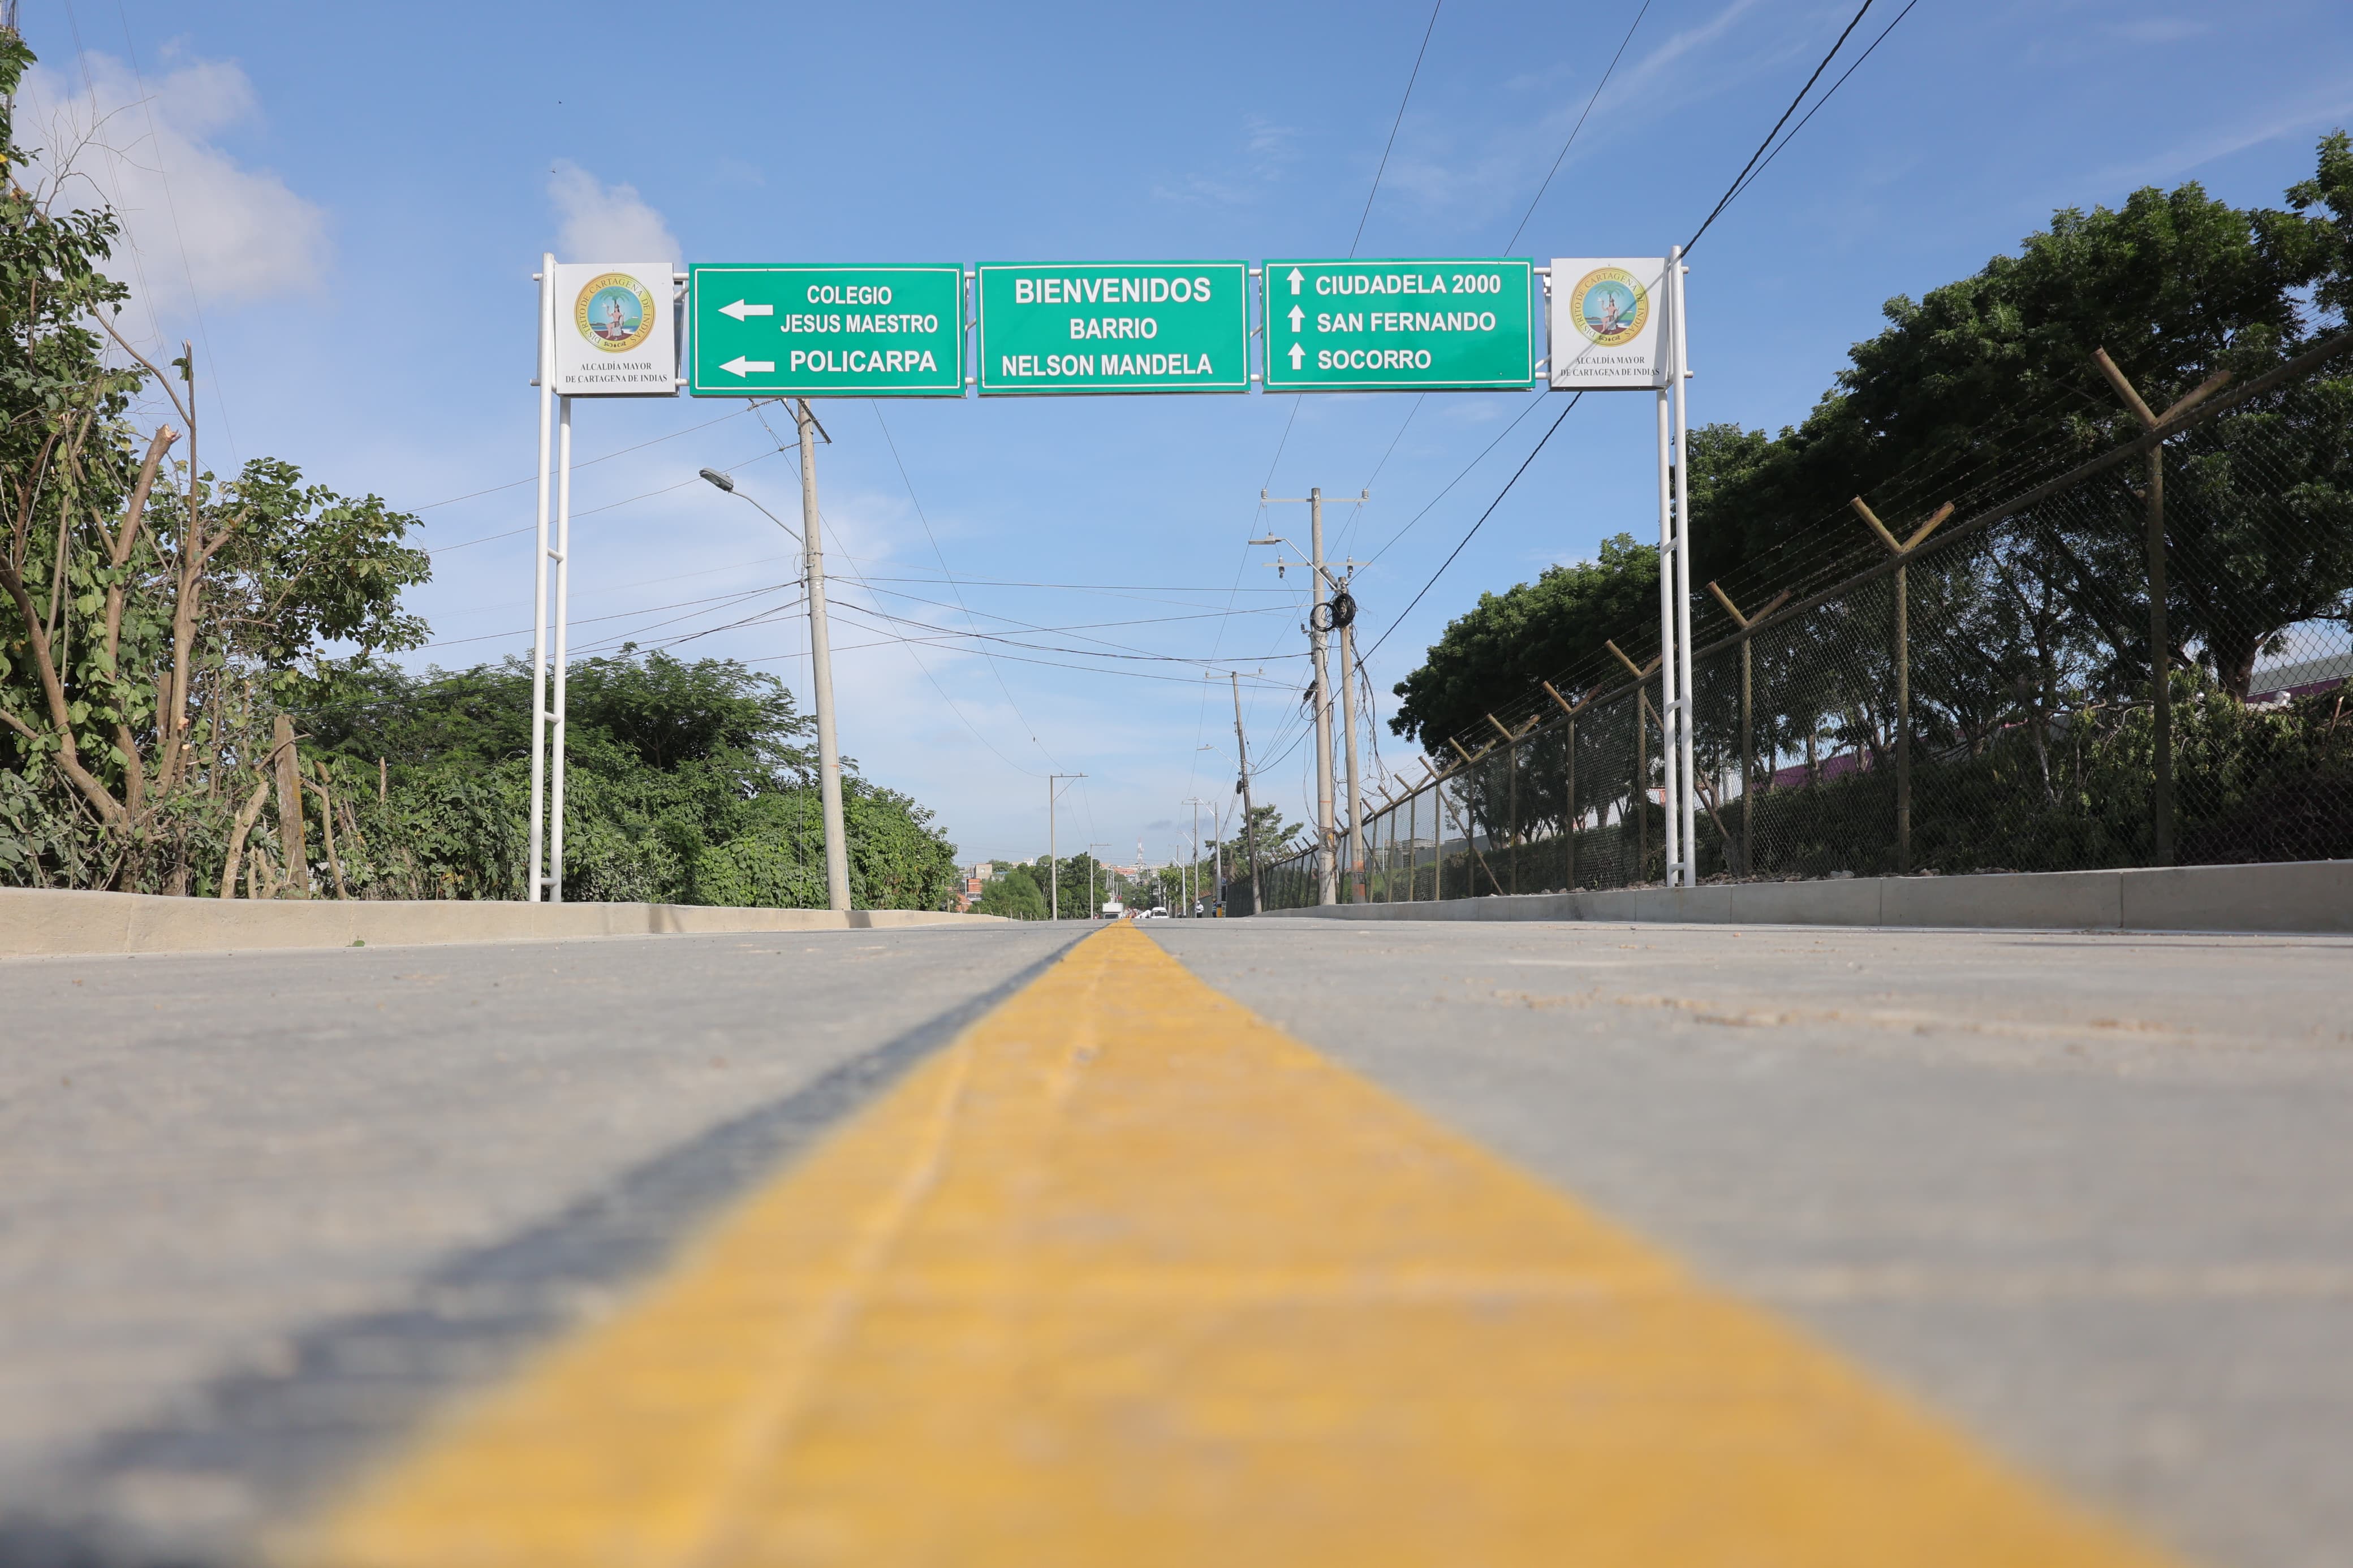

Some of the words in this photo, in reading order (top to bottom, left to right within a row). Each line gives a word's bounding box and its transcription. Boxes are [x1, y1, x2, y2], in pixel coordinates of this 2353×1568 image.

[589, 277, 643, 297] CARTAGENA
[1015, 277, 1211, 304] BIENVENIDOS
[1316, 274, 1447, 295] CIUDADELA
[1452, 274, 1501, 293] 2000
[1584, 271, 1637, 292] CARTAGENA
[581, 295, 591, 308] DE
[641, 298, 651, 310] DE
[807, 285, 892, 305] COLEGIO
[1576, 289, 1586, 302] DE
[1635, 292, 1644, 305] DE
[579, 308, 602, 344] DISTRITO
[630, 313, 651, 343] INDIAS
[780, 314, 841, 333] JESUS
[846, 314, 938, 333] MAESTRO
[1070, 317, 1157, 339] BARRIO
[1317, 313, 1363, 332] SAN
[1371, 312, 1496, 331] FERNANDO
[1574, 302, 1596, 338] DISTRITO
[1624, 307, 1645, 336] INDIAS
[580, 361, 620, 370] ALCALDÍA
[791, 350, 937, 372] POLICARPA
[1002, 355, 1094, 377] NELSON
[1101, 353, 1213, 375] MANDELA
[1318, 349, 1432, 369] SOCORRO
[1575, 355, 1615, 364] ALCALDÍA
[578, 374, 626, 383] CARTAGENA
[640, 374, 667, 382] INDIAS
[1572, 368, 1619, 377] CARTAGENA
[1634, 368, 1660, 376] INDIAS
